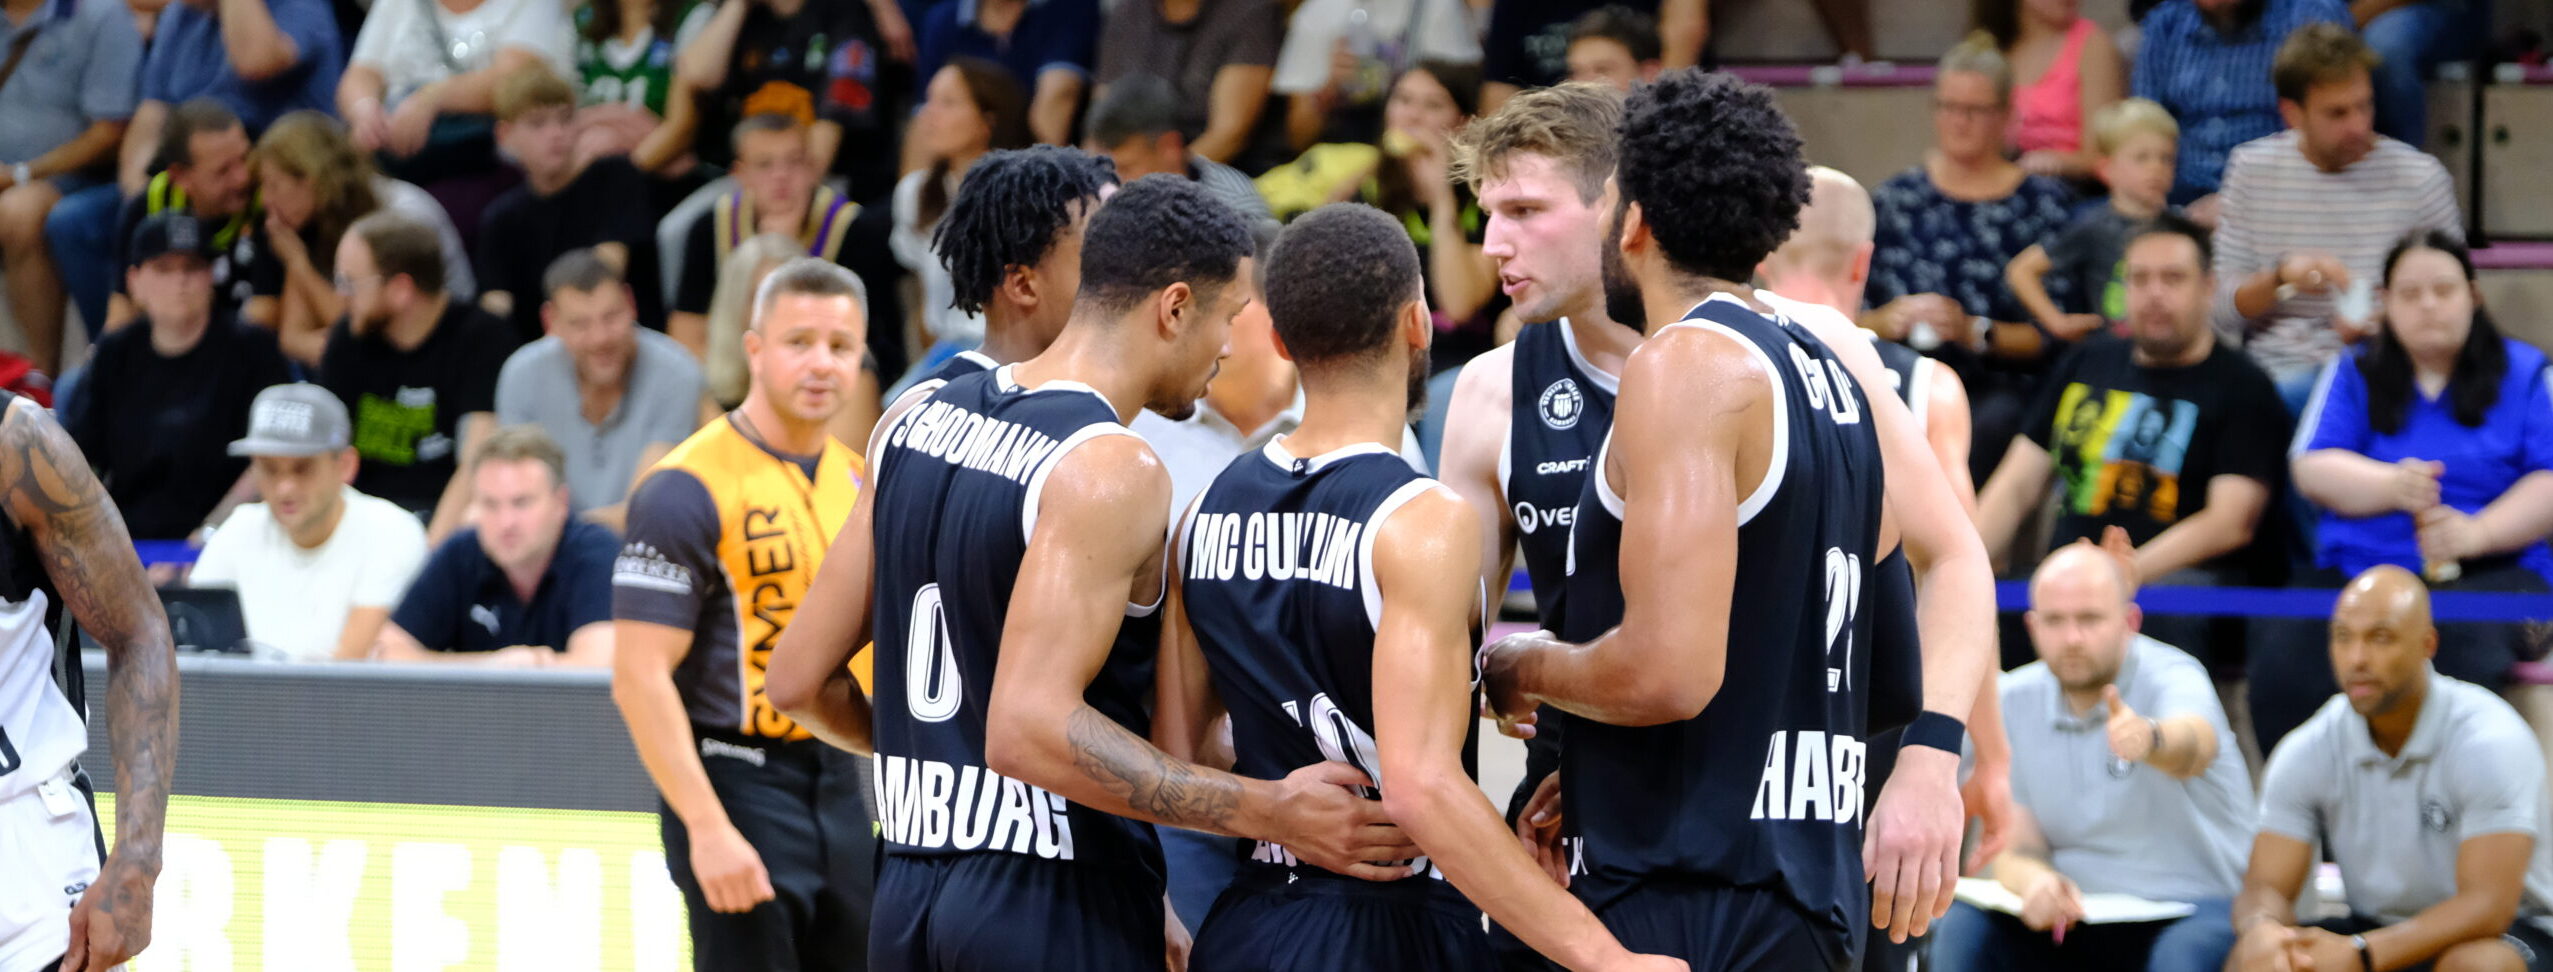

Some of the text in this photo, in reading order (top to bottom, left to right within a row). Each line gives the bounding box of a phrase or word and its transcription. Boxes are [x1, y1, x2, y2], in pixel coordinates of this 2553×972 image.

[1537, 459, 1587, 475] CRAFT
[1190, 512, 1241, 581] MC
[906, 582, 963, 722] 0
